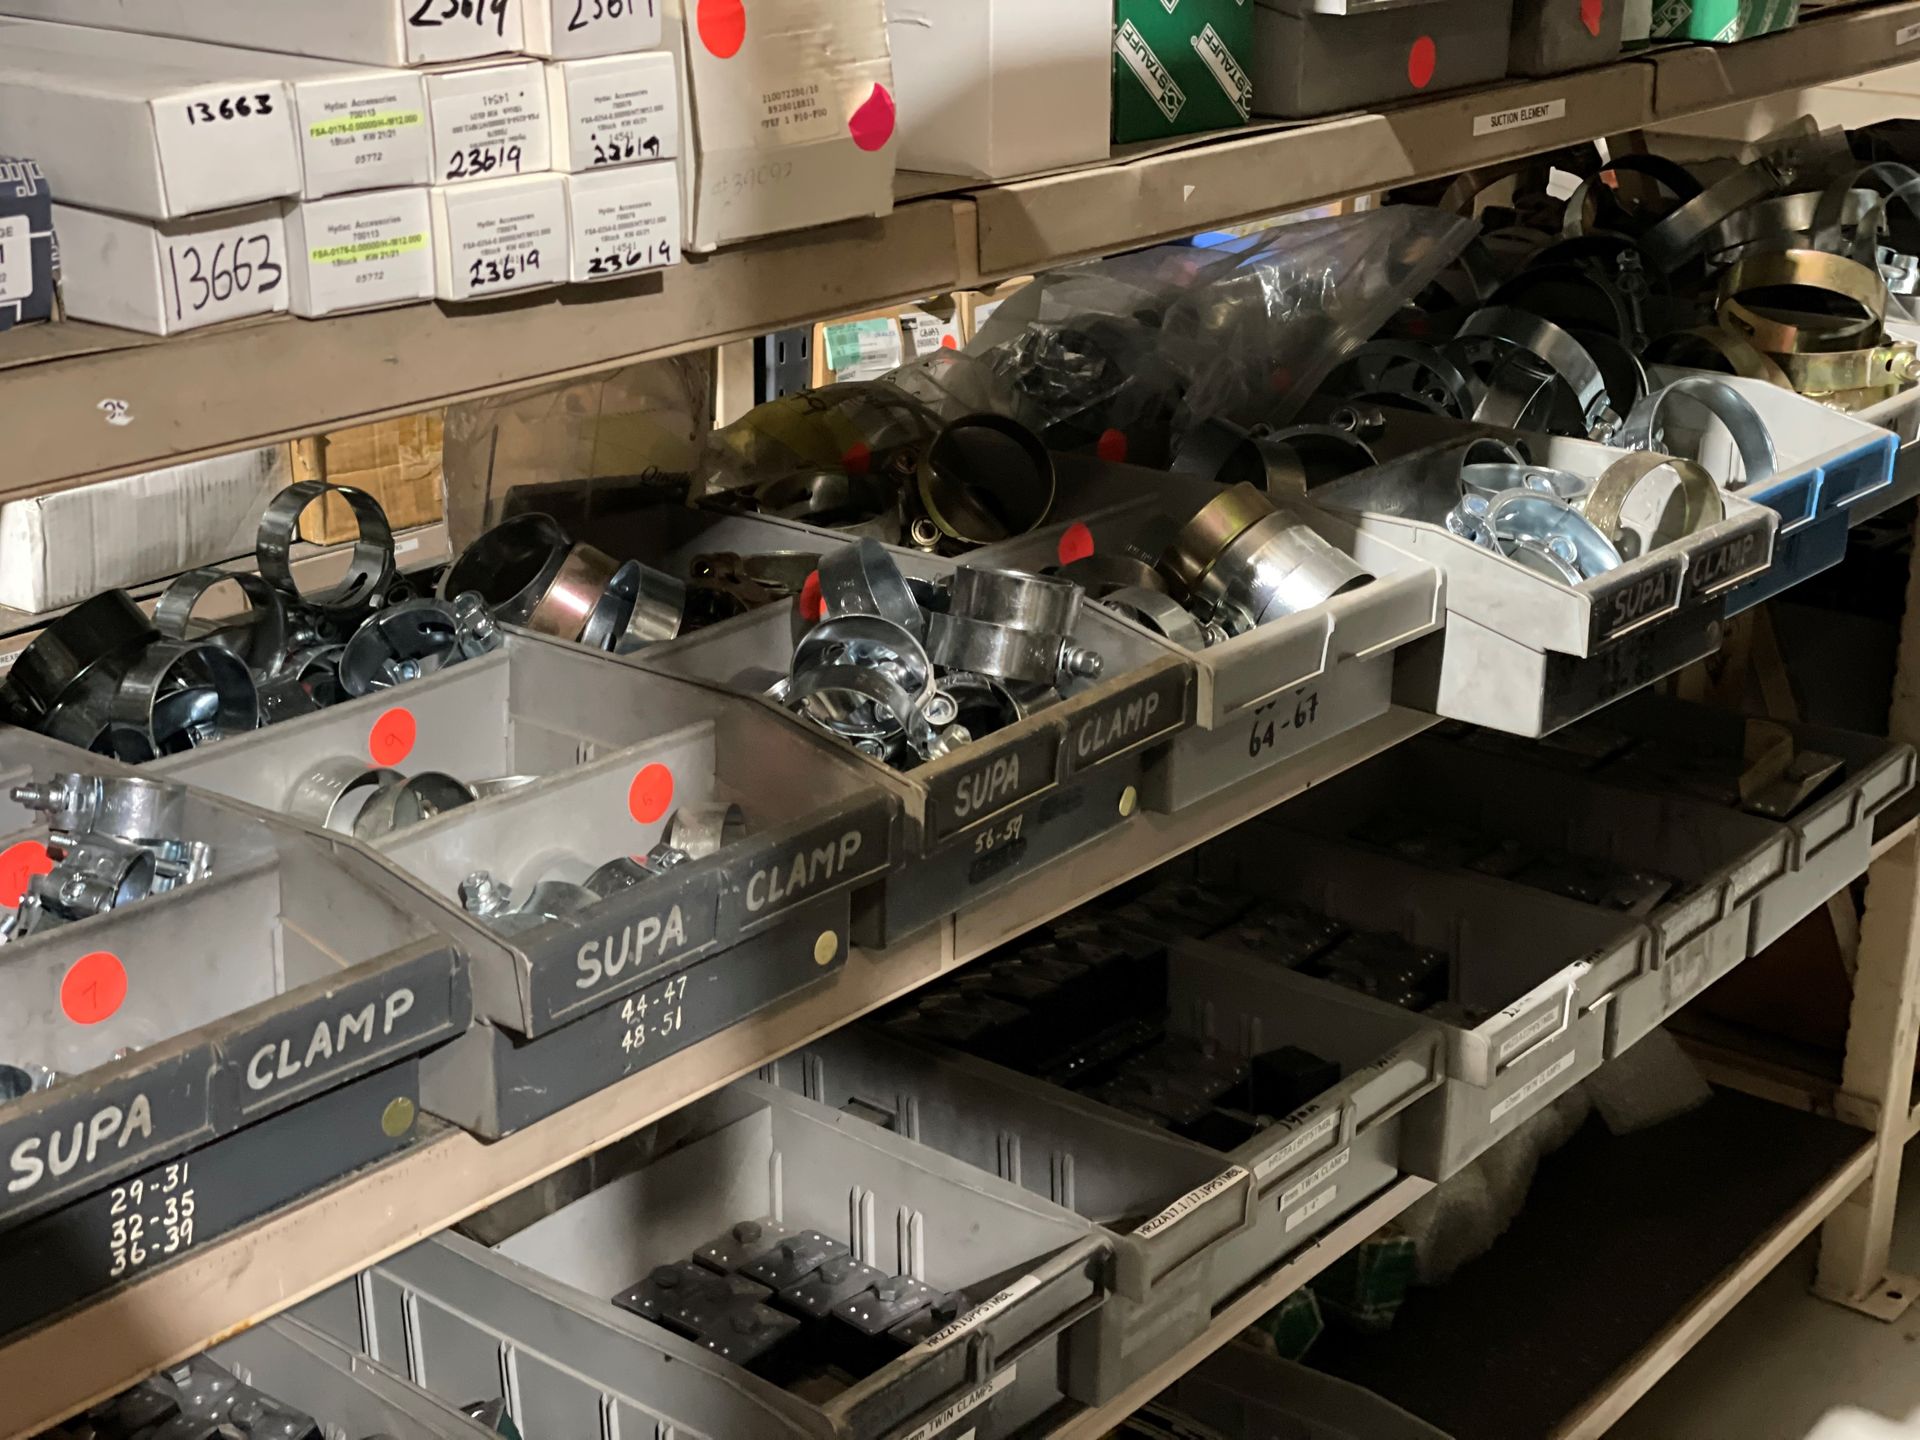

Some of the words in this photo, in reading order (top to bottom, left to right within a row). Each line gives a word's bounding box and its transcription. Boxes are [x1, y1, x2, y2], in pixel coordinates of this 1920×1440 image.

[1122, 29, 1170, 88] STAUFF
[1202, 33, 1247, 92] STAUFF
[187, 94, 273, 125] 13663
[351, 95, 397, 107] Accessories
[1491, 112, 1519, 127] SUCTION
[1521, 105, 1549, 121] ELEMENT
[446, 145, 521, 180] 23619
[355, 216, 402, 229] Accessories
[169, 234, 282, 320] 13663
[469, 249, 540, 287] 23619
[587, 240, 671, 274] 23619
[1612, 576, 1667, 626] SUPA
[1691, 533, 1755, 587] CLAMP
[1249, 691, 1319, 757] 64-67
[954, 754, 1020, 817] SUPA
[1077, 692, 1160, 758] CLAMP
[576, 904, 687, 989] SUPA
[746, 831, 862, 912] CLAMP
[621, 975, 688, 1024] 44-47
[621, 1006, 683, 1053] 48-51
[8, 1094, 153, 1193] SUPA
[246, 988, 415, 1091] CLAMP
[110, 1162, 188, 1216] 29-31
[110, 1188, 195, 1248] 32-35
[110, 1218, 193, 1276] 36-39
[929, 1408, 954, 1432] TWIN
[957, 1381, 994, 1413] CLAMPS
